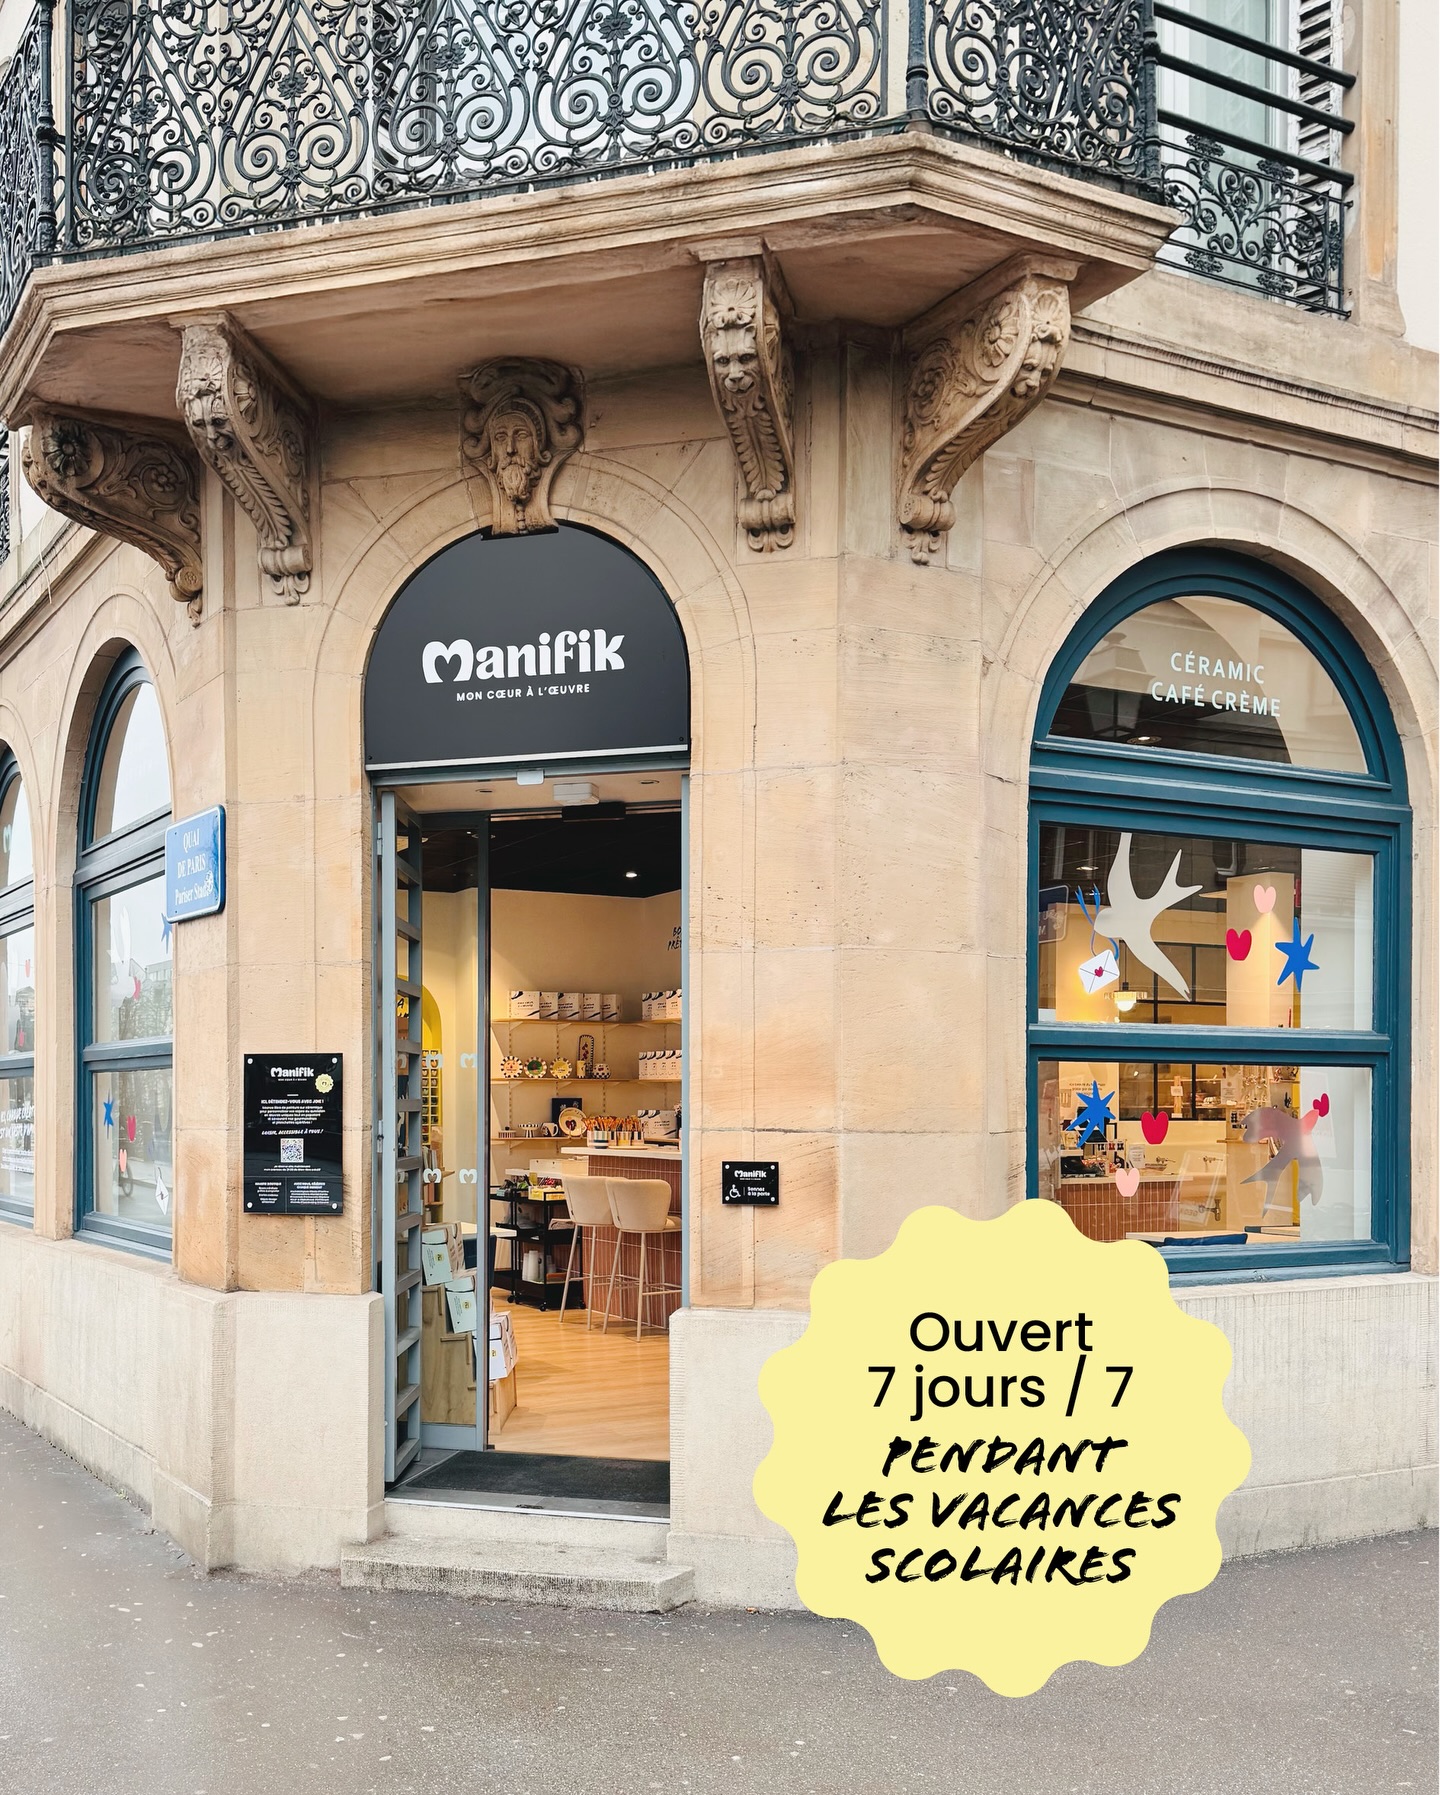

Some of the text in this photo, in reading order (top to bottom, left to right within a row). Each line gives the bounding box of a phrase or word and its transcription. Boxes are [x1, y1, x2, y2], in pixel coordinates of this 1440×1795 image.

[422, 628, 625, 684] Manifik
[1170, 650, 1265, 684] CÉRAMIC
[456, 683, 590, 702] MON CŒUR À L'ŒUVRE
[1151, 681, 1281, 717] CAFÉ CRÈME
[183, 828, 200, 853] QUAI
[177, 853, 206, 879] DE PARIS
[175, 882, 211, 906] Pariser Stad
[270, 1067, 314, 1077] Manifik
[734, 1169, 767, 1178] Manifik
